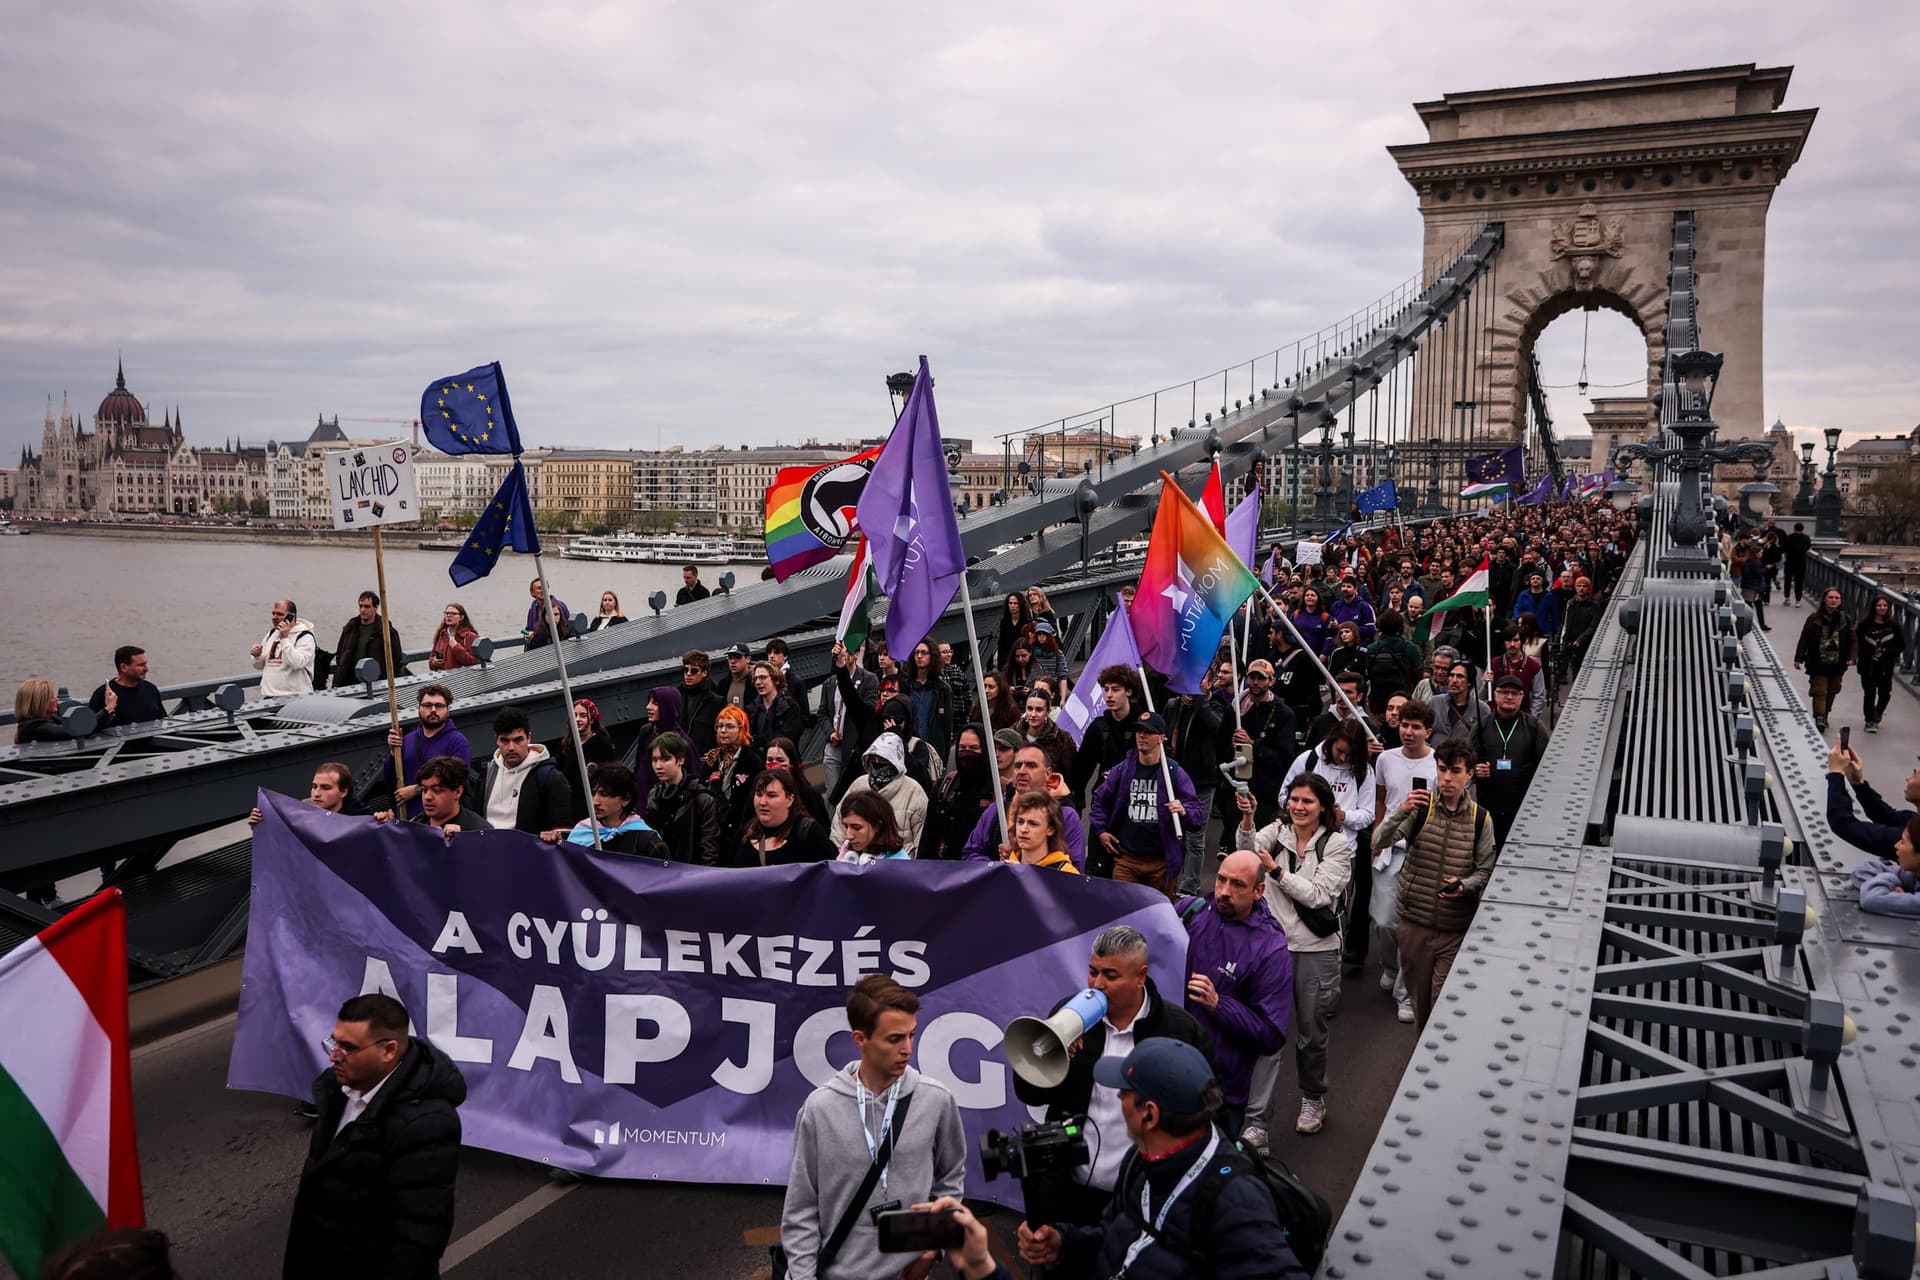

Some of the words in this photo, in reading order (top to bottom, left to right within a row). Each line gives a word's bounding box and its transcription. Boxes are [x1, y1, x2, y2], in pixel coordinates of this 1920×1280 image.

[1128, 806, 1159, 820] NIA
[431, 911, 483, 954] A
[507, 908, 931, 987] GYÜLEKEZÉS
[624, 1127, 726, 1148] MOMENTUM
